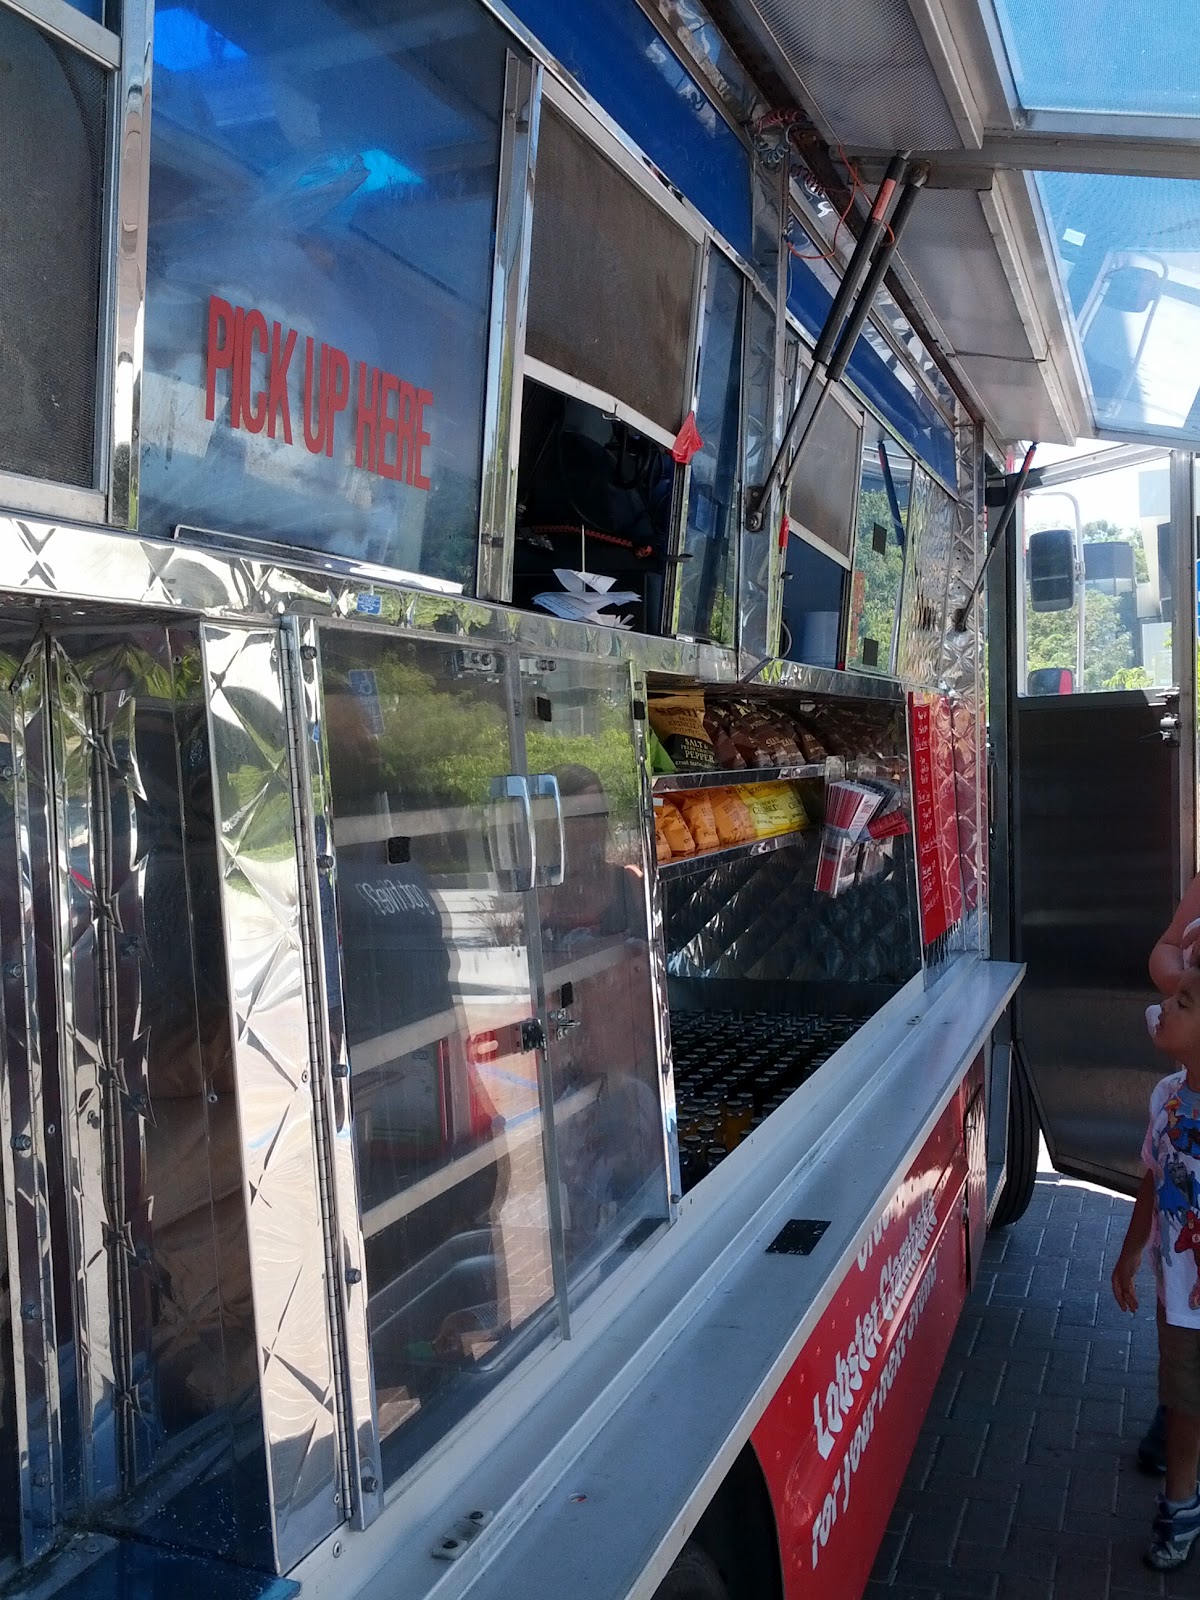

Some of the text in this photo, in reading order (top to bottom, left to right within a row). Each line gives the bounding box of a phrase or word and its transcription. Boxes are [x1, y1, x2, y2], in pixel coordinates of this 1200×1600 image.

[205, 293, 434, 491] PICK UP HERE
[684, 738, 703, 749] SALT
[685, 750, 716, 764] PEPPER
[813, 1296, 883, 1460] Lobster
[843, 1386, 878, 1514] your
[879, 1320, 907, 1412] next
